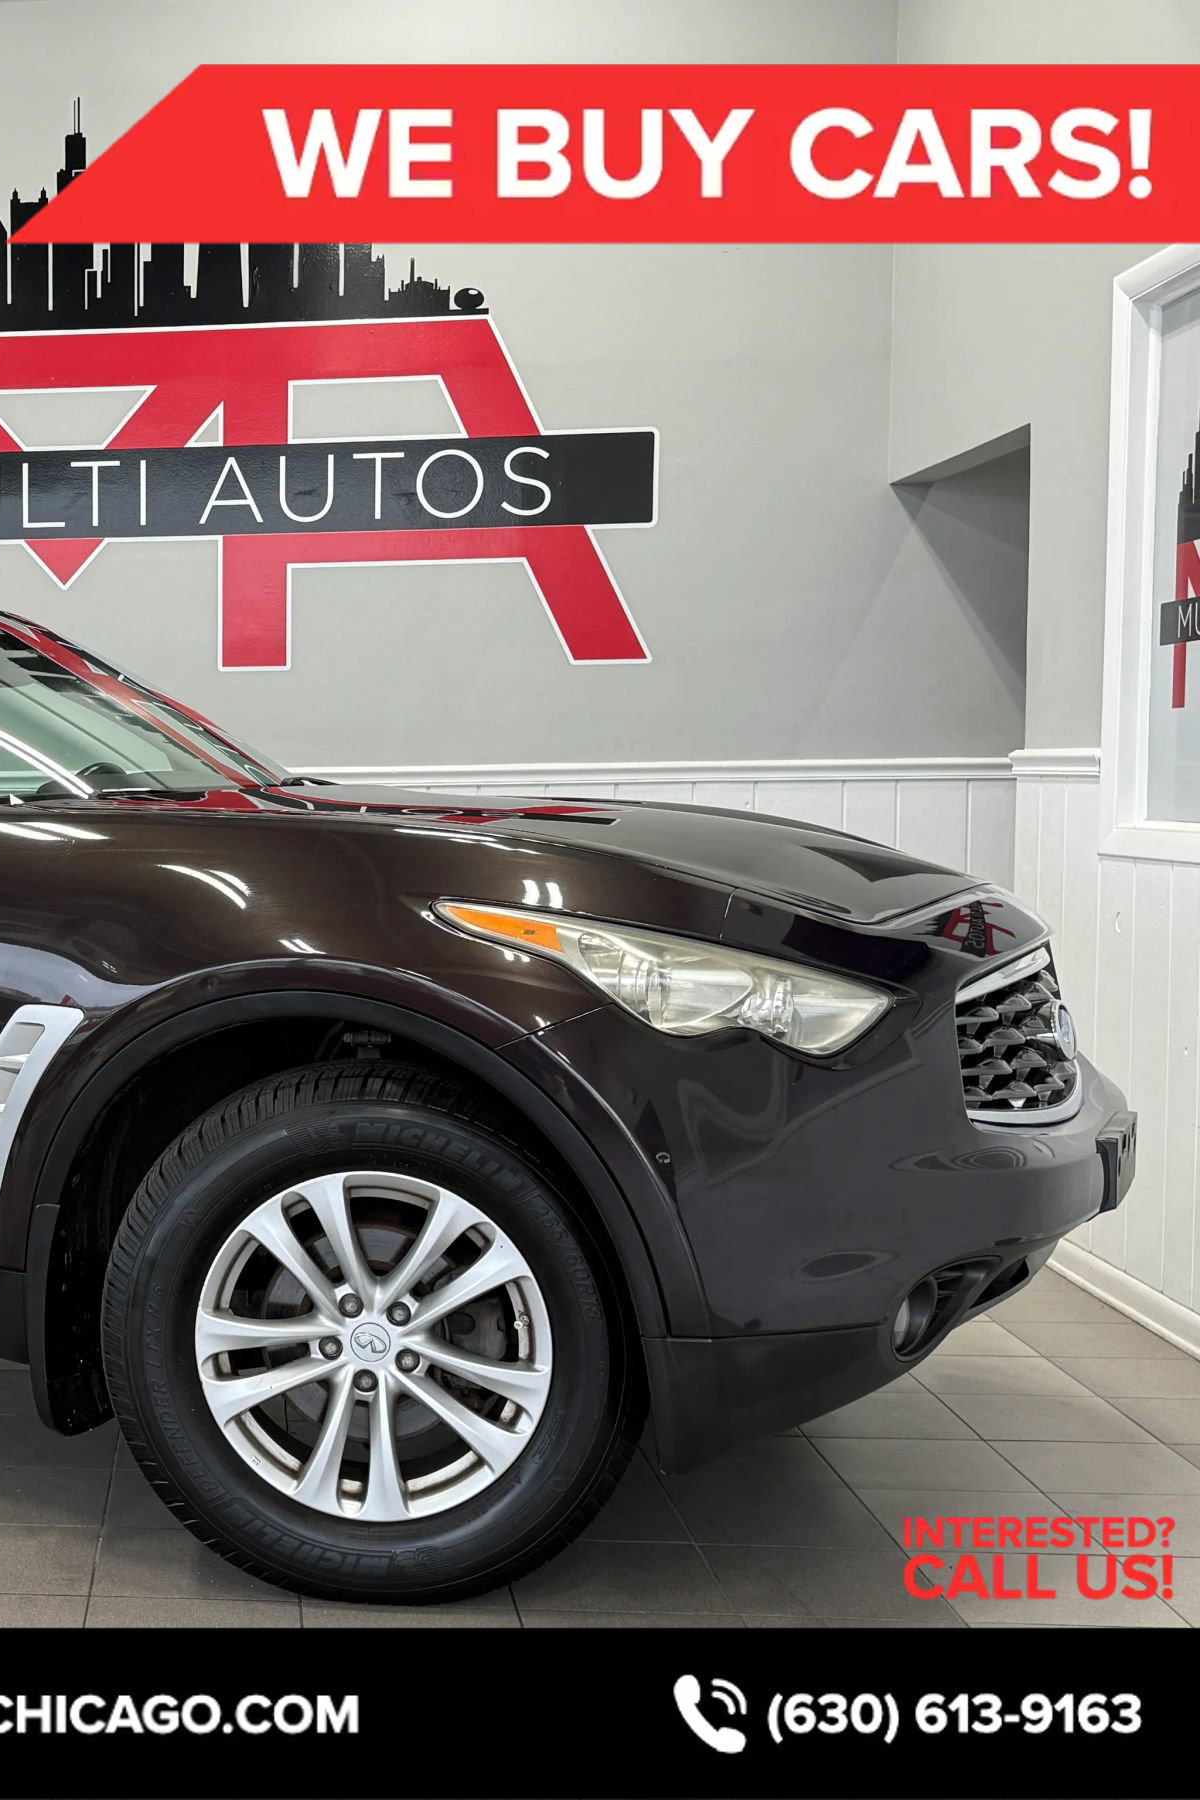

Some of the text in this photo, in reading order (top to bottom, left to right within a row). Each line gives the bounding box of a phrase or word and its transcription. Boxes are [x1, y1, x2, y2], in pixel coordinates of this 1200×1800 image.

[198, 446, 552, 525] AUTOS
[355, 1121, 523, 1193] MICHELIN
[150, 1377, 224, 1500] DEFENDER
[222, 1502, 392, 1578] MICHELIN
